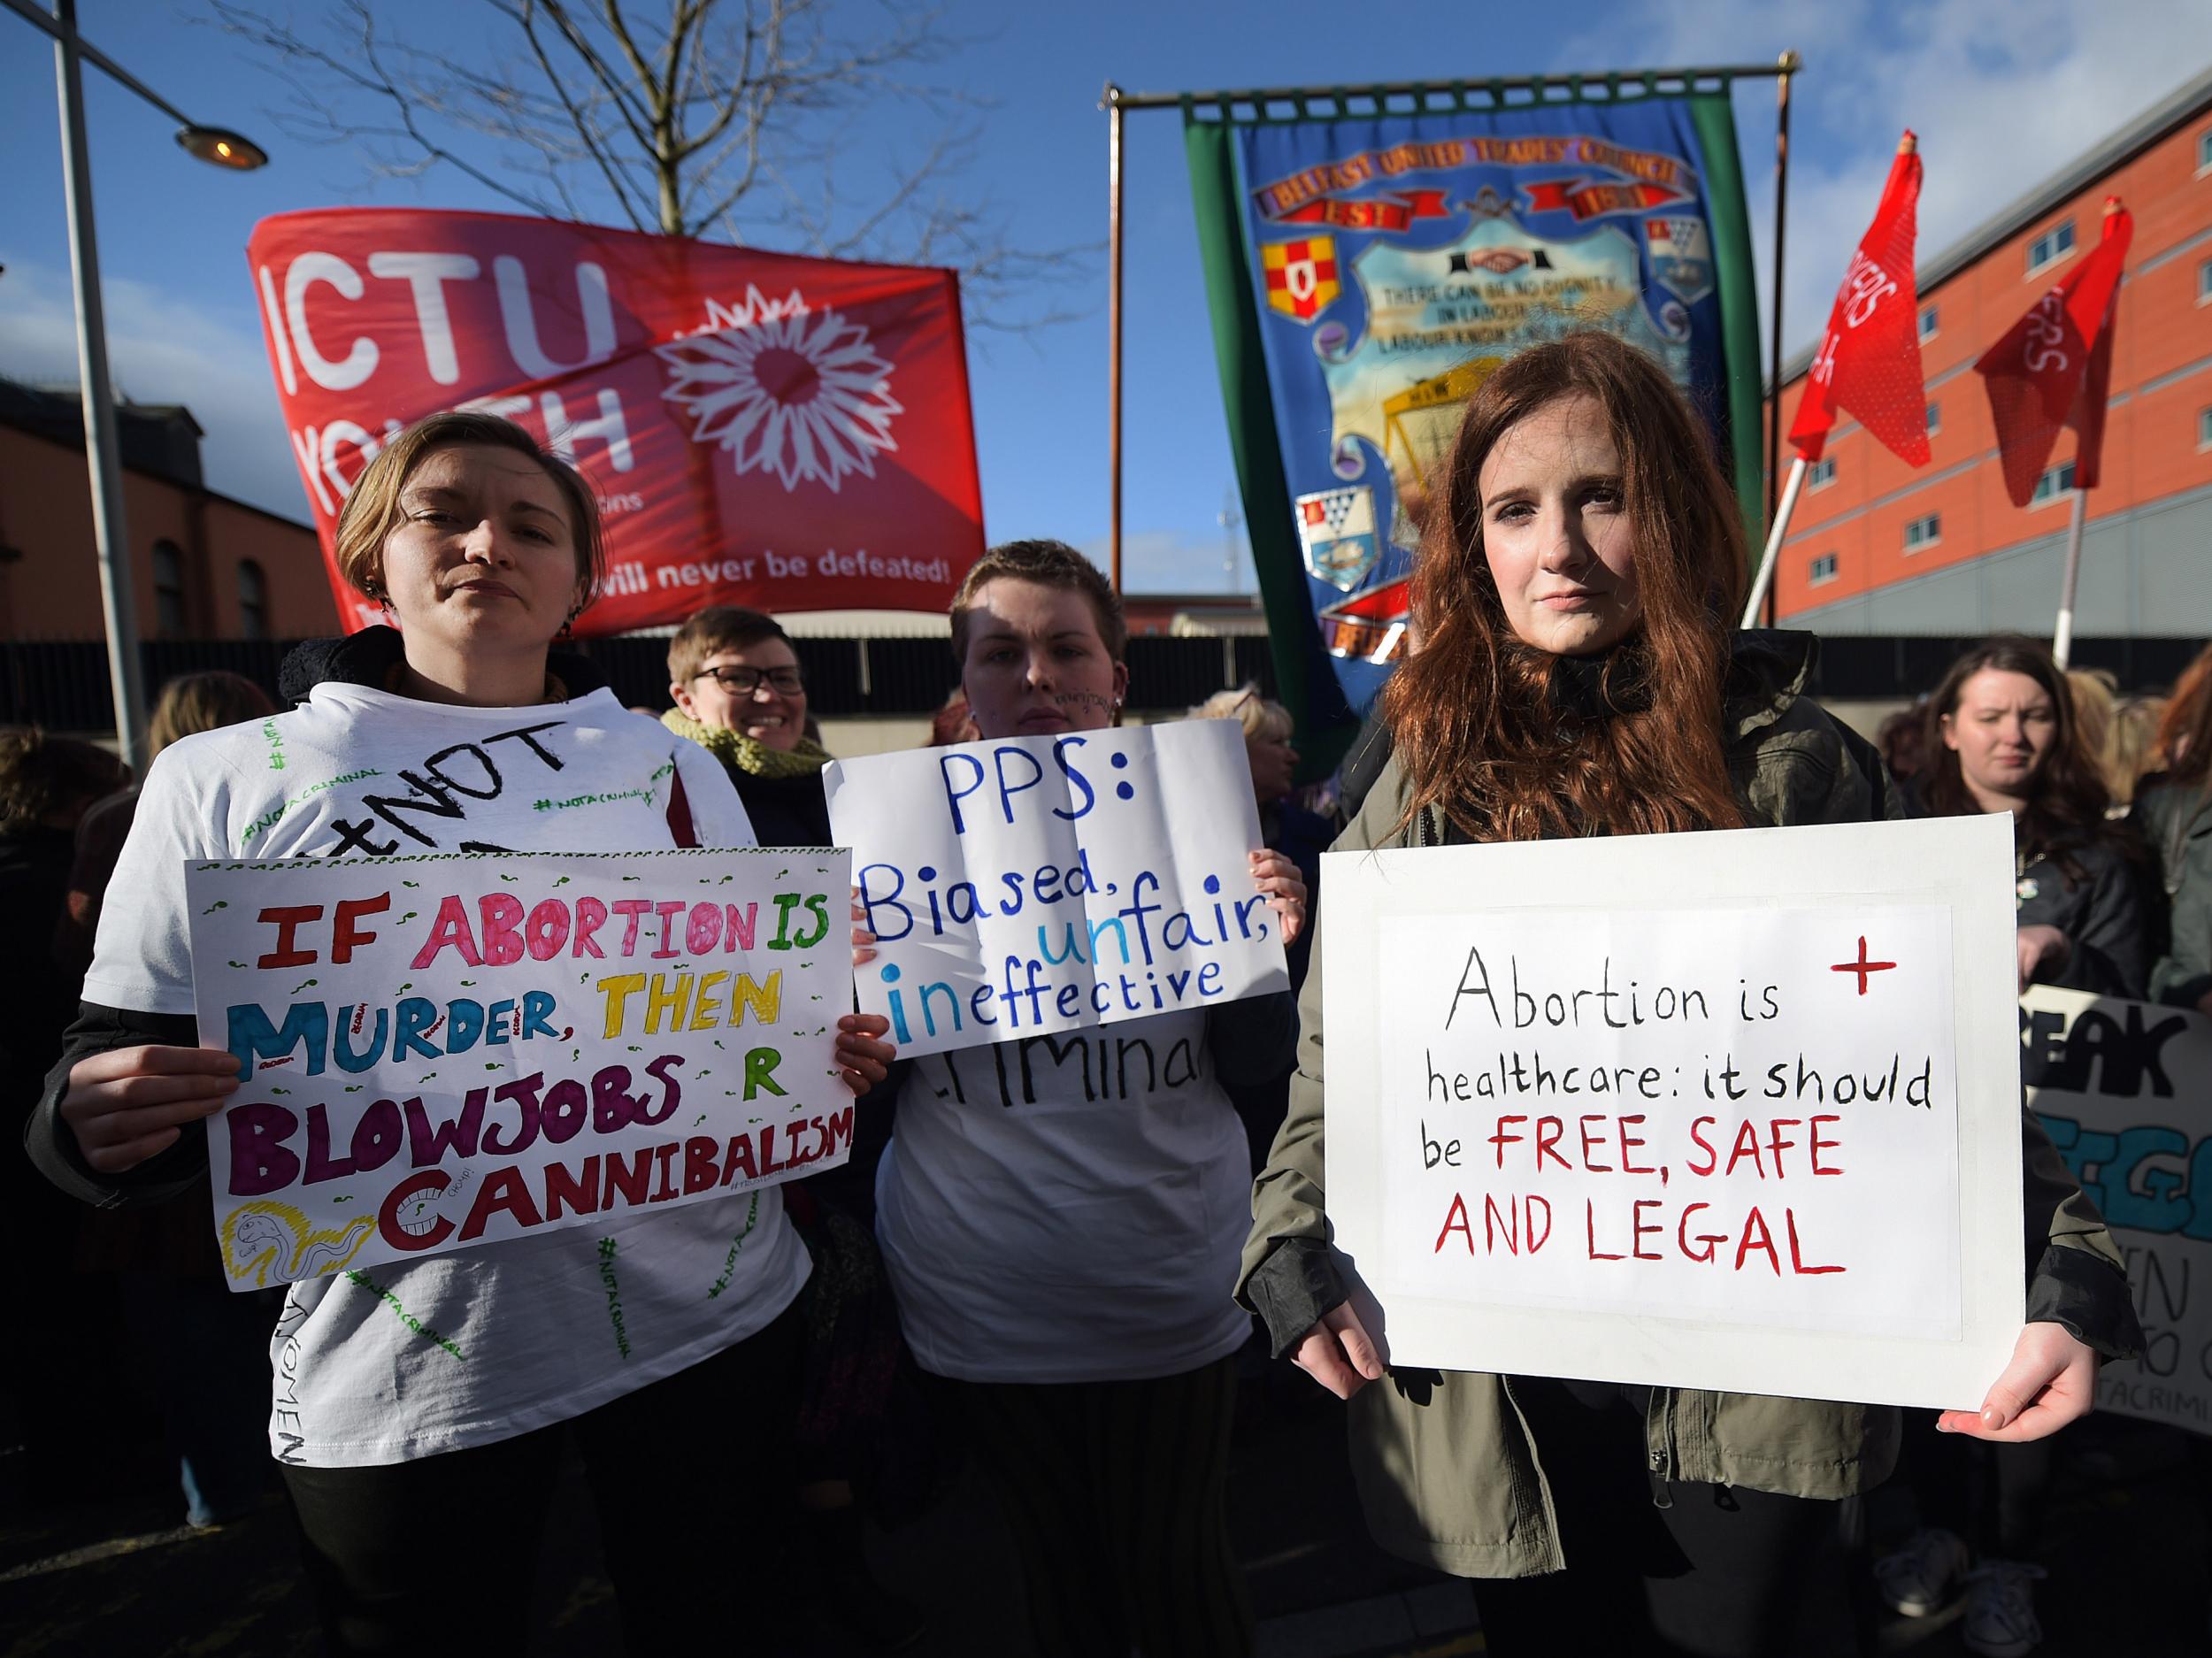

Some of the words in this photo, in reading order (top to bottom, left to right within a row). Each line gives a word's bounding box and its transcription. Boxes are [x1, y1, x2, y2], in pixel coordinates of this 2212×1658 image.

[1272, 153, 1373, 211] BELFAST
[1379, 142, 1465, 176] UNITED
[259, 251, 618, 396] ICTU
[1385, 285, 1438, 306] THERE
[1443, 283, 1481, 302] CAN
[1514, 280, 1541, 297] NO
[657, 557, 757, 587] never
[764, 549, 808, 579] be
[818, 549, 952, 585] defeated!
[940, 736, 1135, 834] PPS:
[257, 892, 391, 969] IF
[410, 893, 758, 971] ABORTION
[767, 893, 830, 951] IS
[858, 848, 1118, 942] Biased,
[1038, 871, 1270, 966] unfair,
[227, 990, 575, 1083] MURDER,
[596, 969, 783, 1039] THEN
[880, 956, 1224, 1045] ineffective
[1446, 946, 1709, 1032] Abortion
[1740, 979, 1779, 1022] is
[227, 1054, 686, 1196] BLOWJOBS
[743, 1047, 789, 1101] R
[1426, 1048, 1680, 1104] healthcare:
[1703, 1053, 1748, 1101] it
[1763, 1051, 1932, 1109] should
[378, 1106, 854, 1251] CANNIBALISM
[1421, 1118, 1463, 1171] be
[1487, 1114, 1669, 1187] FREE,
[1686, 1115, 1846, 1181] SAFE
[1434, 1192, 1551, 1257] AND
[1586, 1200, 1847, 1278] LEGAL
